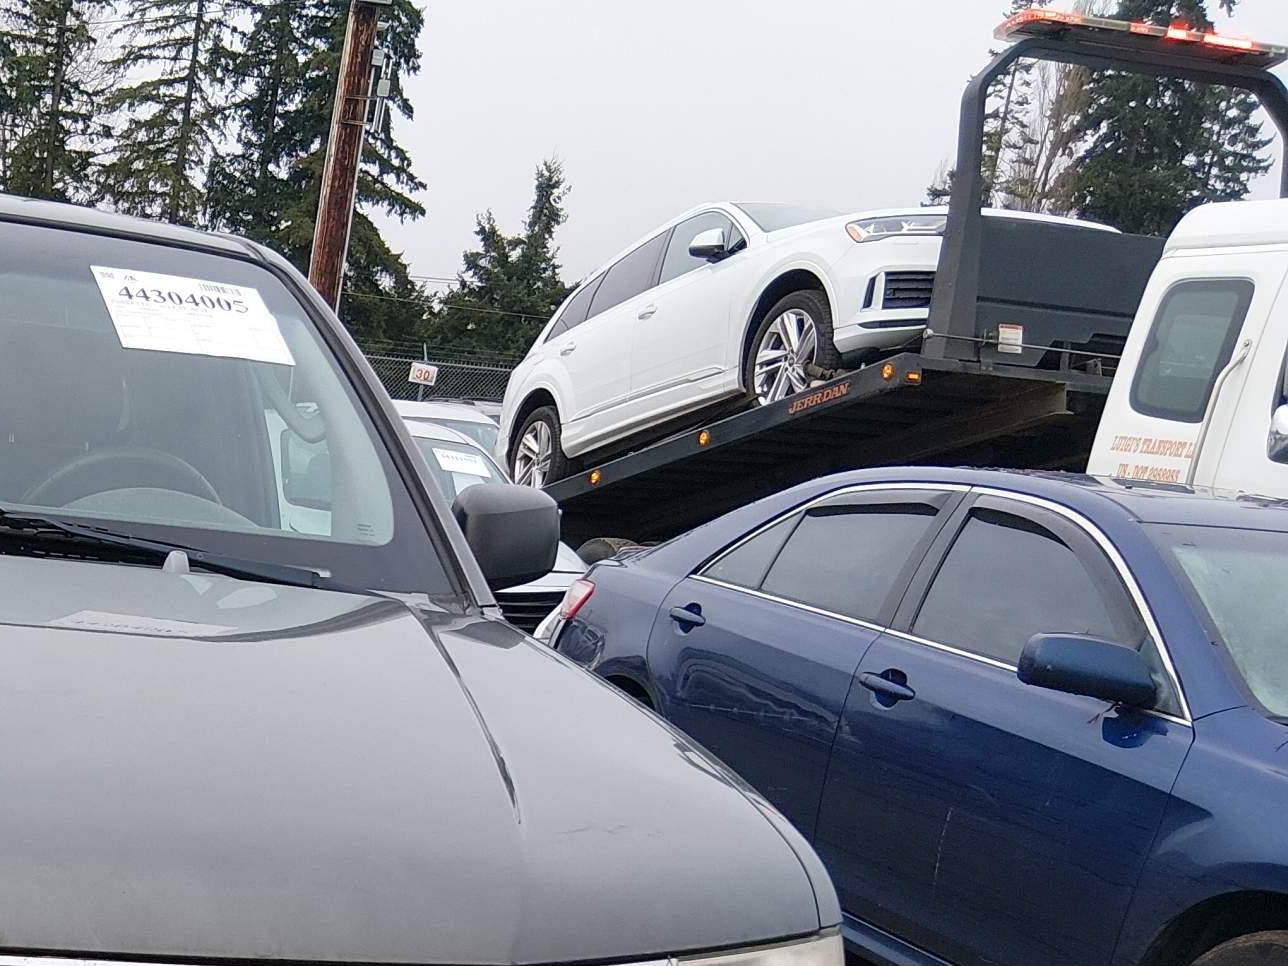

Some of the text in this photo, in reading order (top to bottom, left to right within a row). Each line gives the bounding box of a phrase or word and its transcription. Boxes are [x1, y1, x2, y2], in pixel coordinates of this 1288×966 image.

[118, 286, 249, 314] 44304005
[415, 368, 430, 380] 30
[1140, 438, 1186, 457] TRANSPORT
